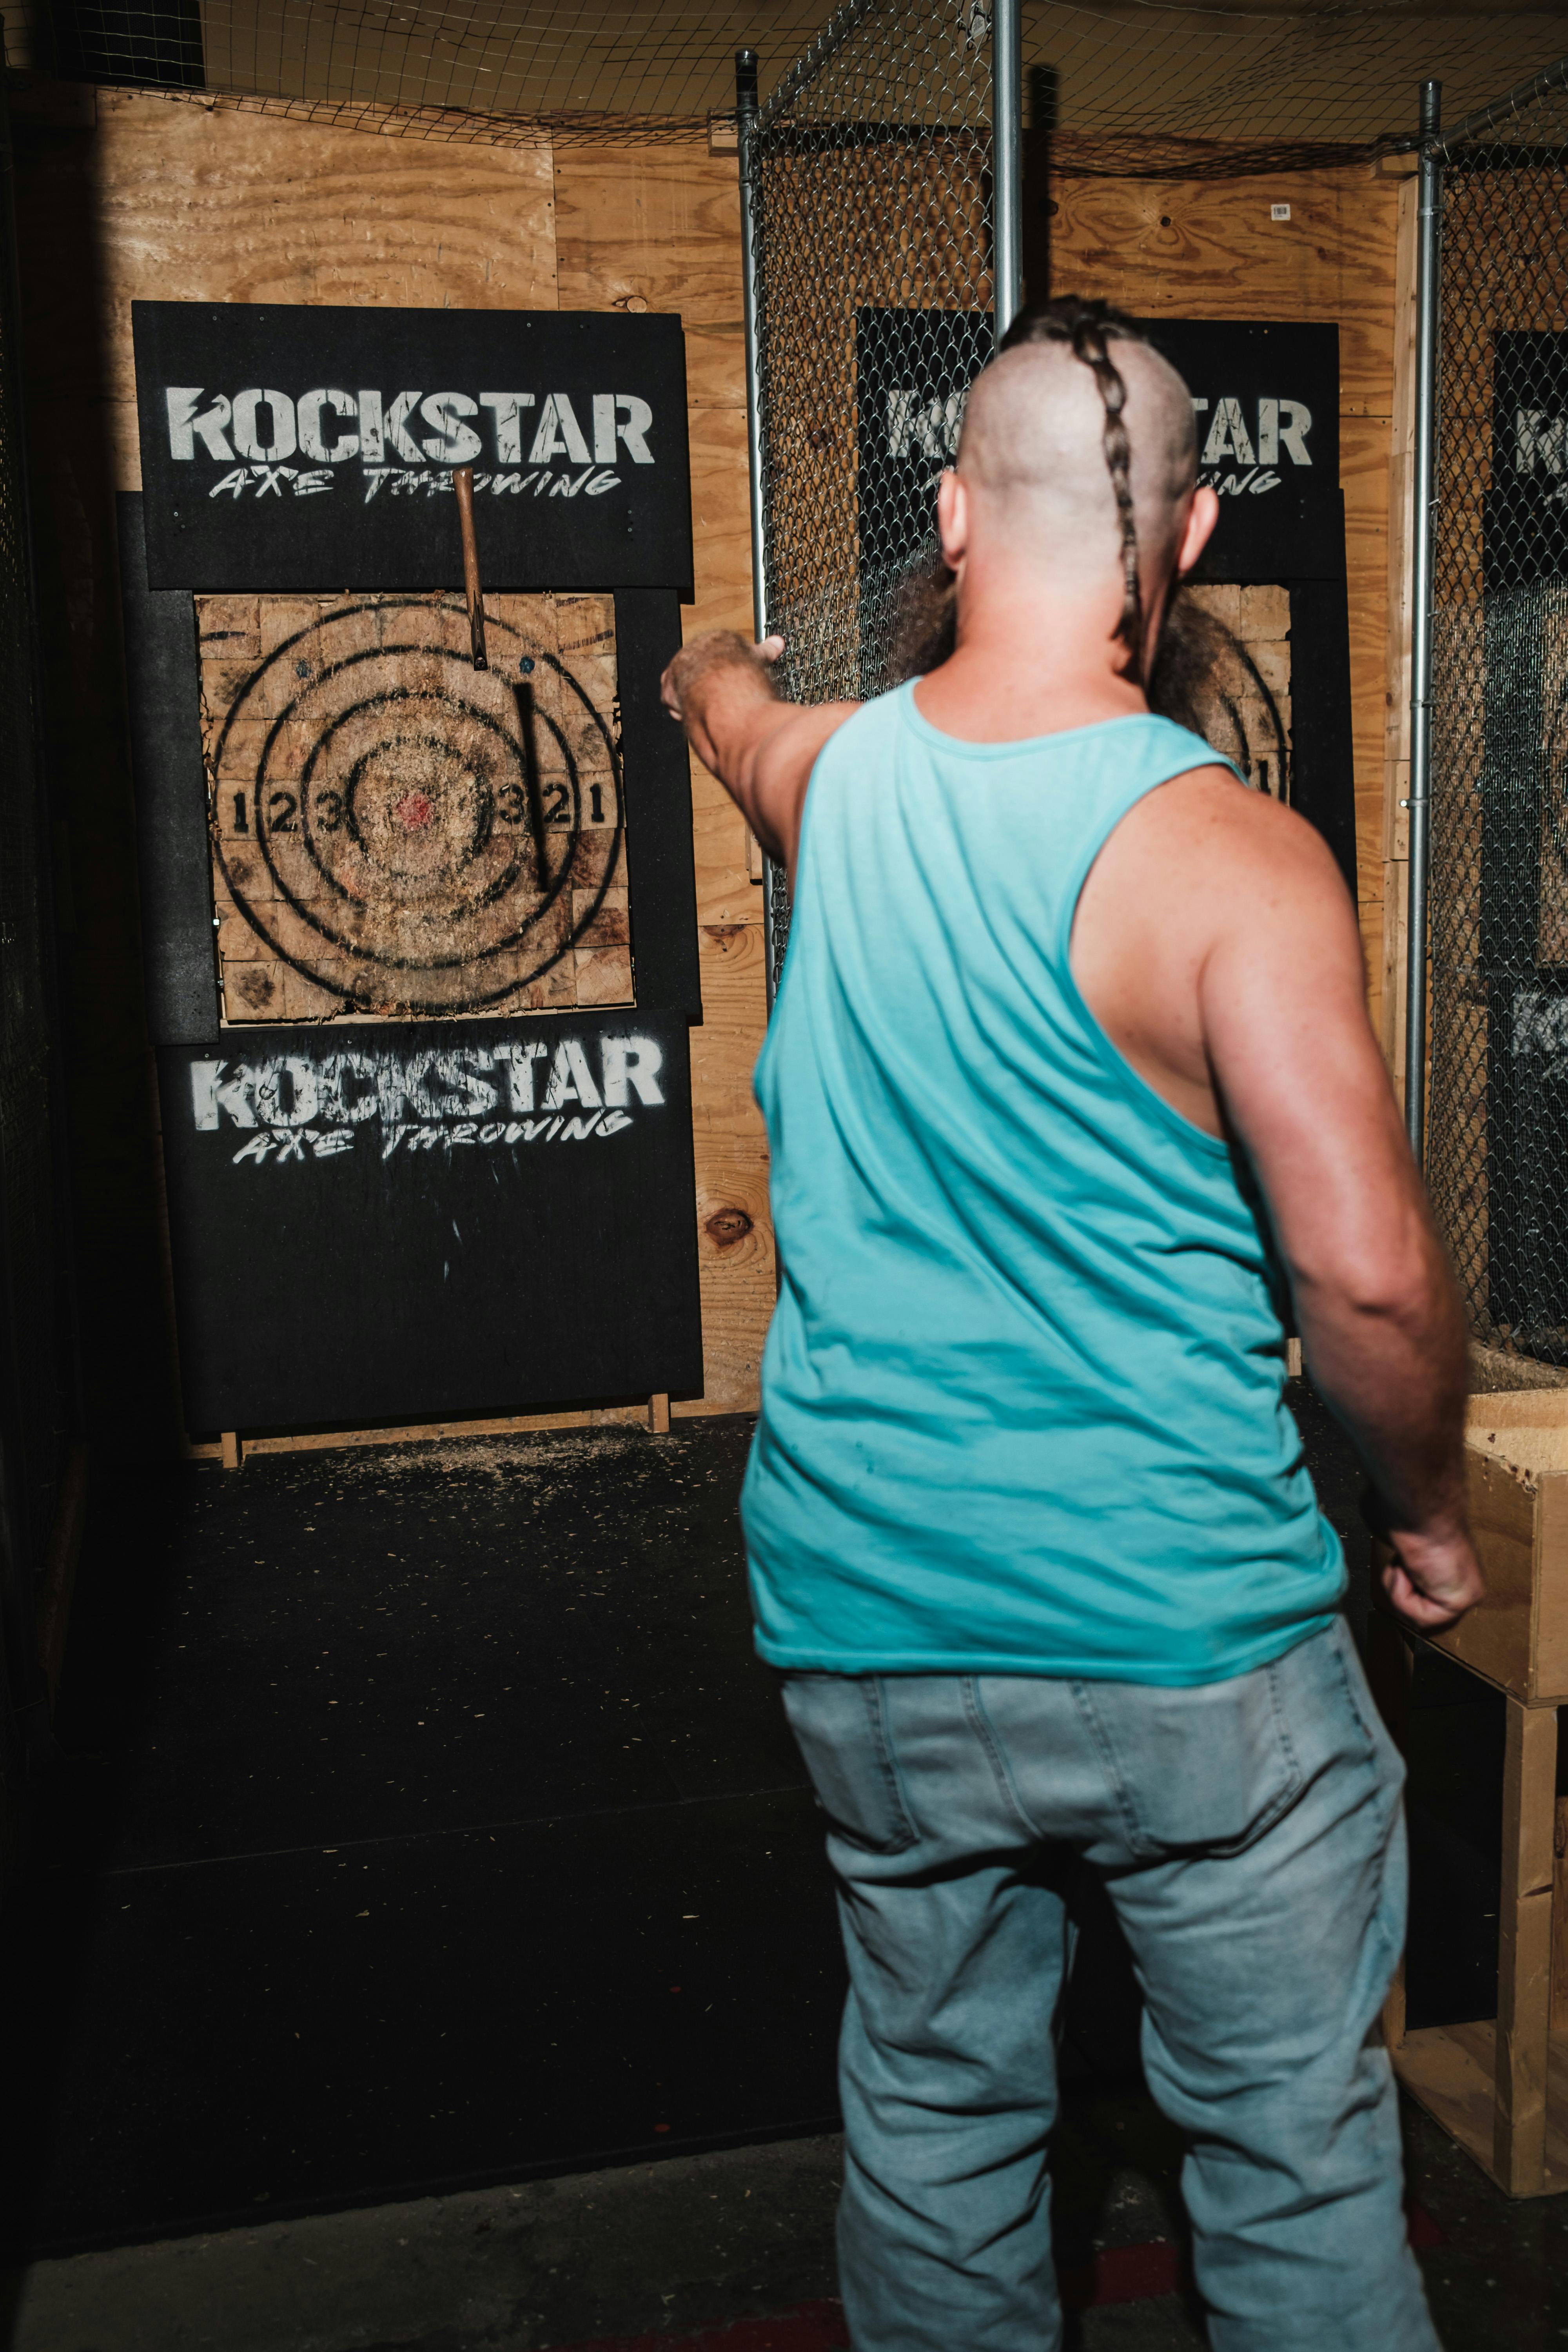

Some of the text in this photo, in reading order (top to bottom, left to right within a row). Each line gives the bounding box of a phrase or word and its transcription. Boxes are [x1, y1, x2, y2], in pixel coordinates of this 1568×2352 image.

[166, 387, 655, 464] ROCKSTAR
[209, 465, 621, 503] AXE THROWING
[233, 783, 604, 833] 1 2 3 3 2 1
[191, 1037, 665, 1131] ROCKSTAR
[232, 1108, 633, 1163] AXE THROWING
